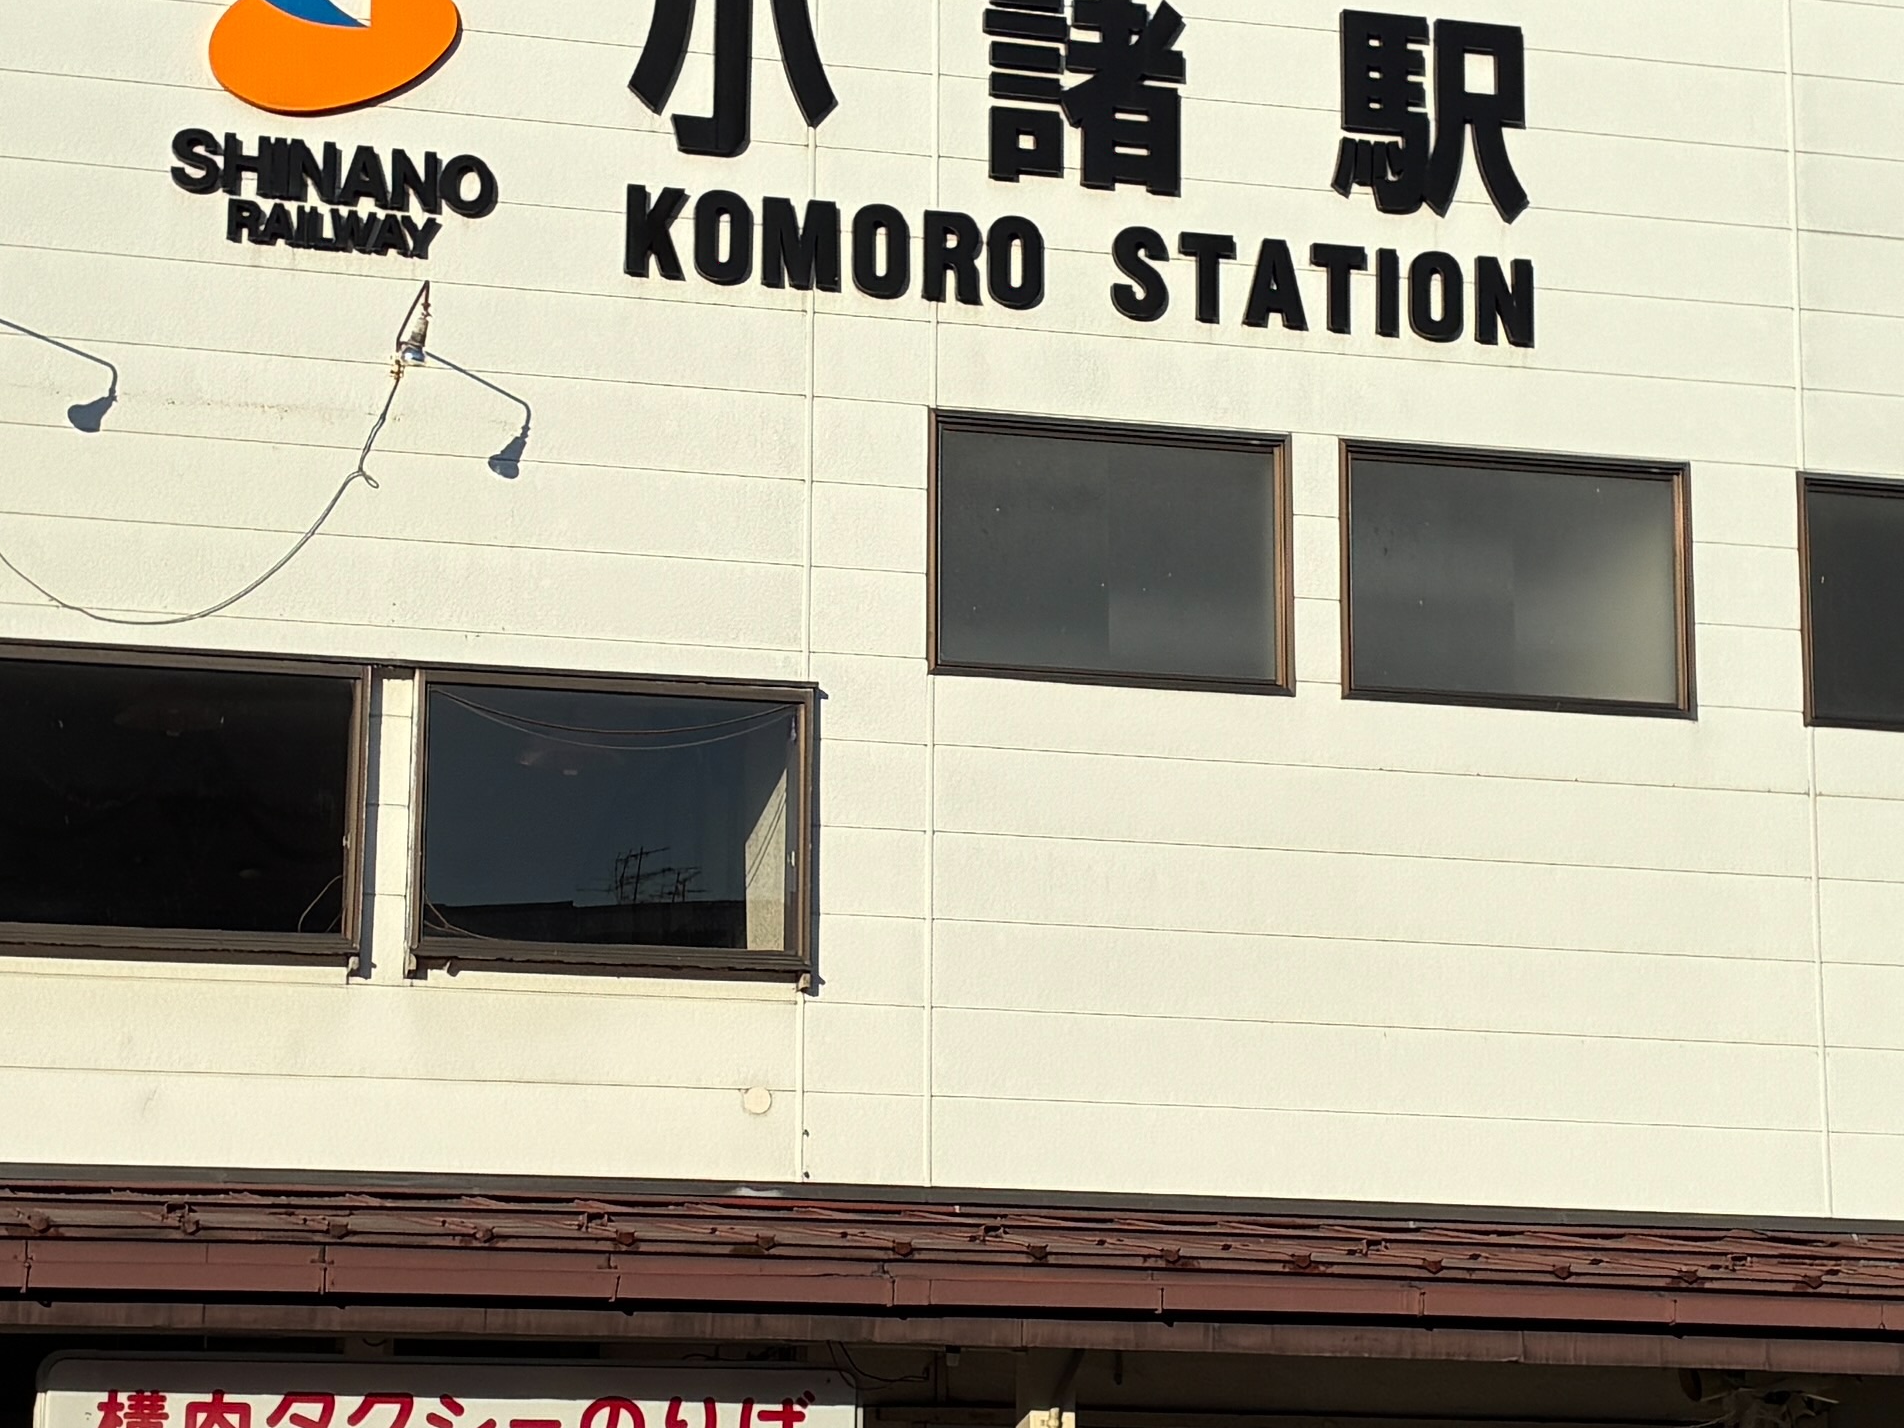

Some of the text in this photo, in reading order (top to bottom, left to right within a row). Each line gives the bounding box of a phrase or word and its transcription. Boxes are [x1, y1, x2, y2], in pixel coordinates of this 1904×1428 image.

[170, 127, 499, 220] SHINANO
[225, 197, 442, 260] RAILWAY
[623, 183, 1537, 350] KOMORO STATION
